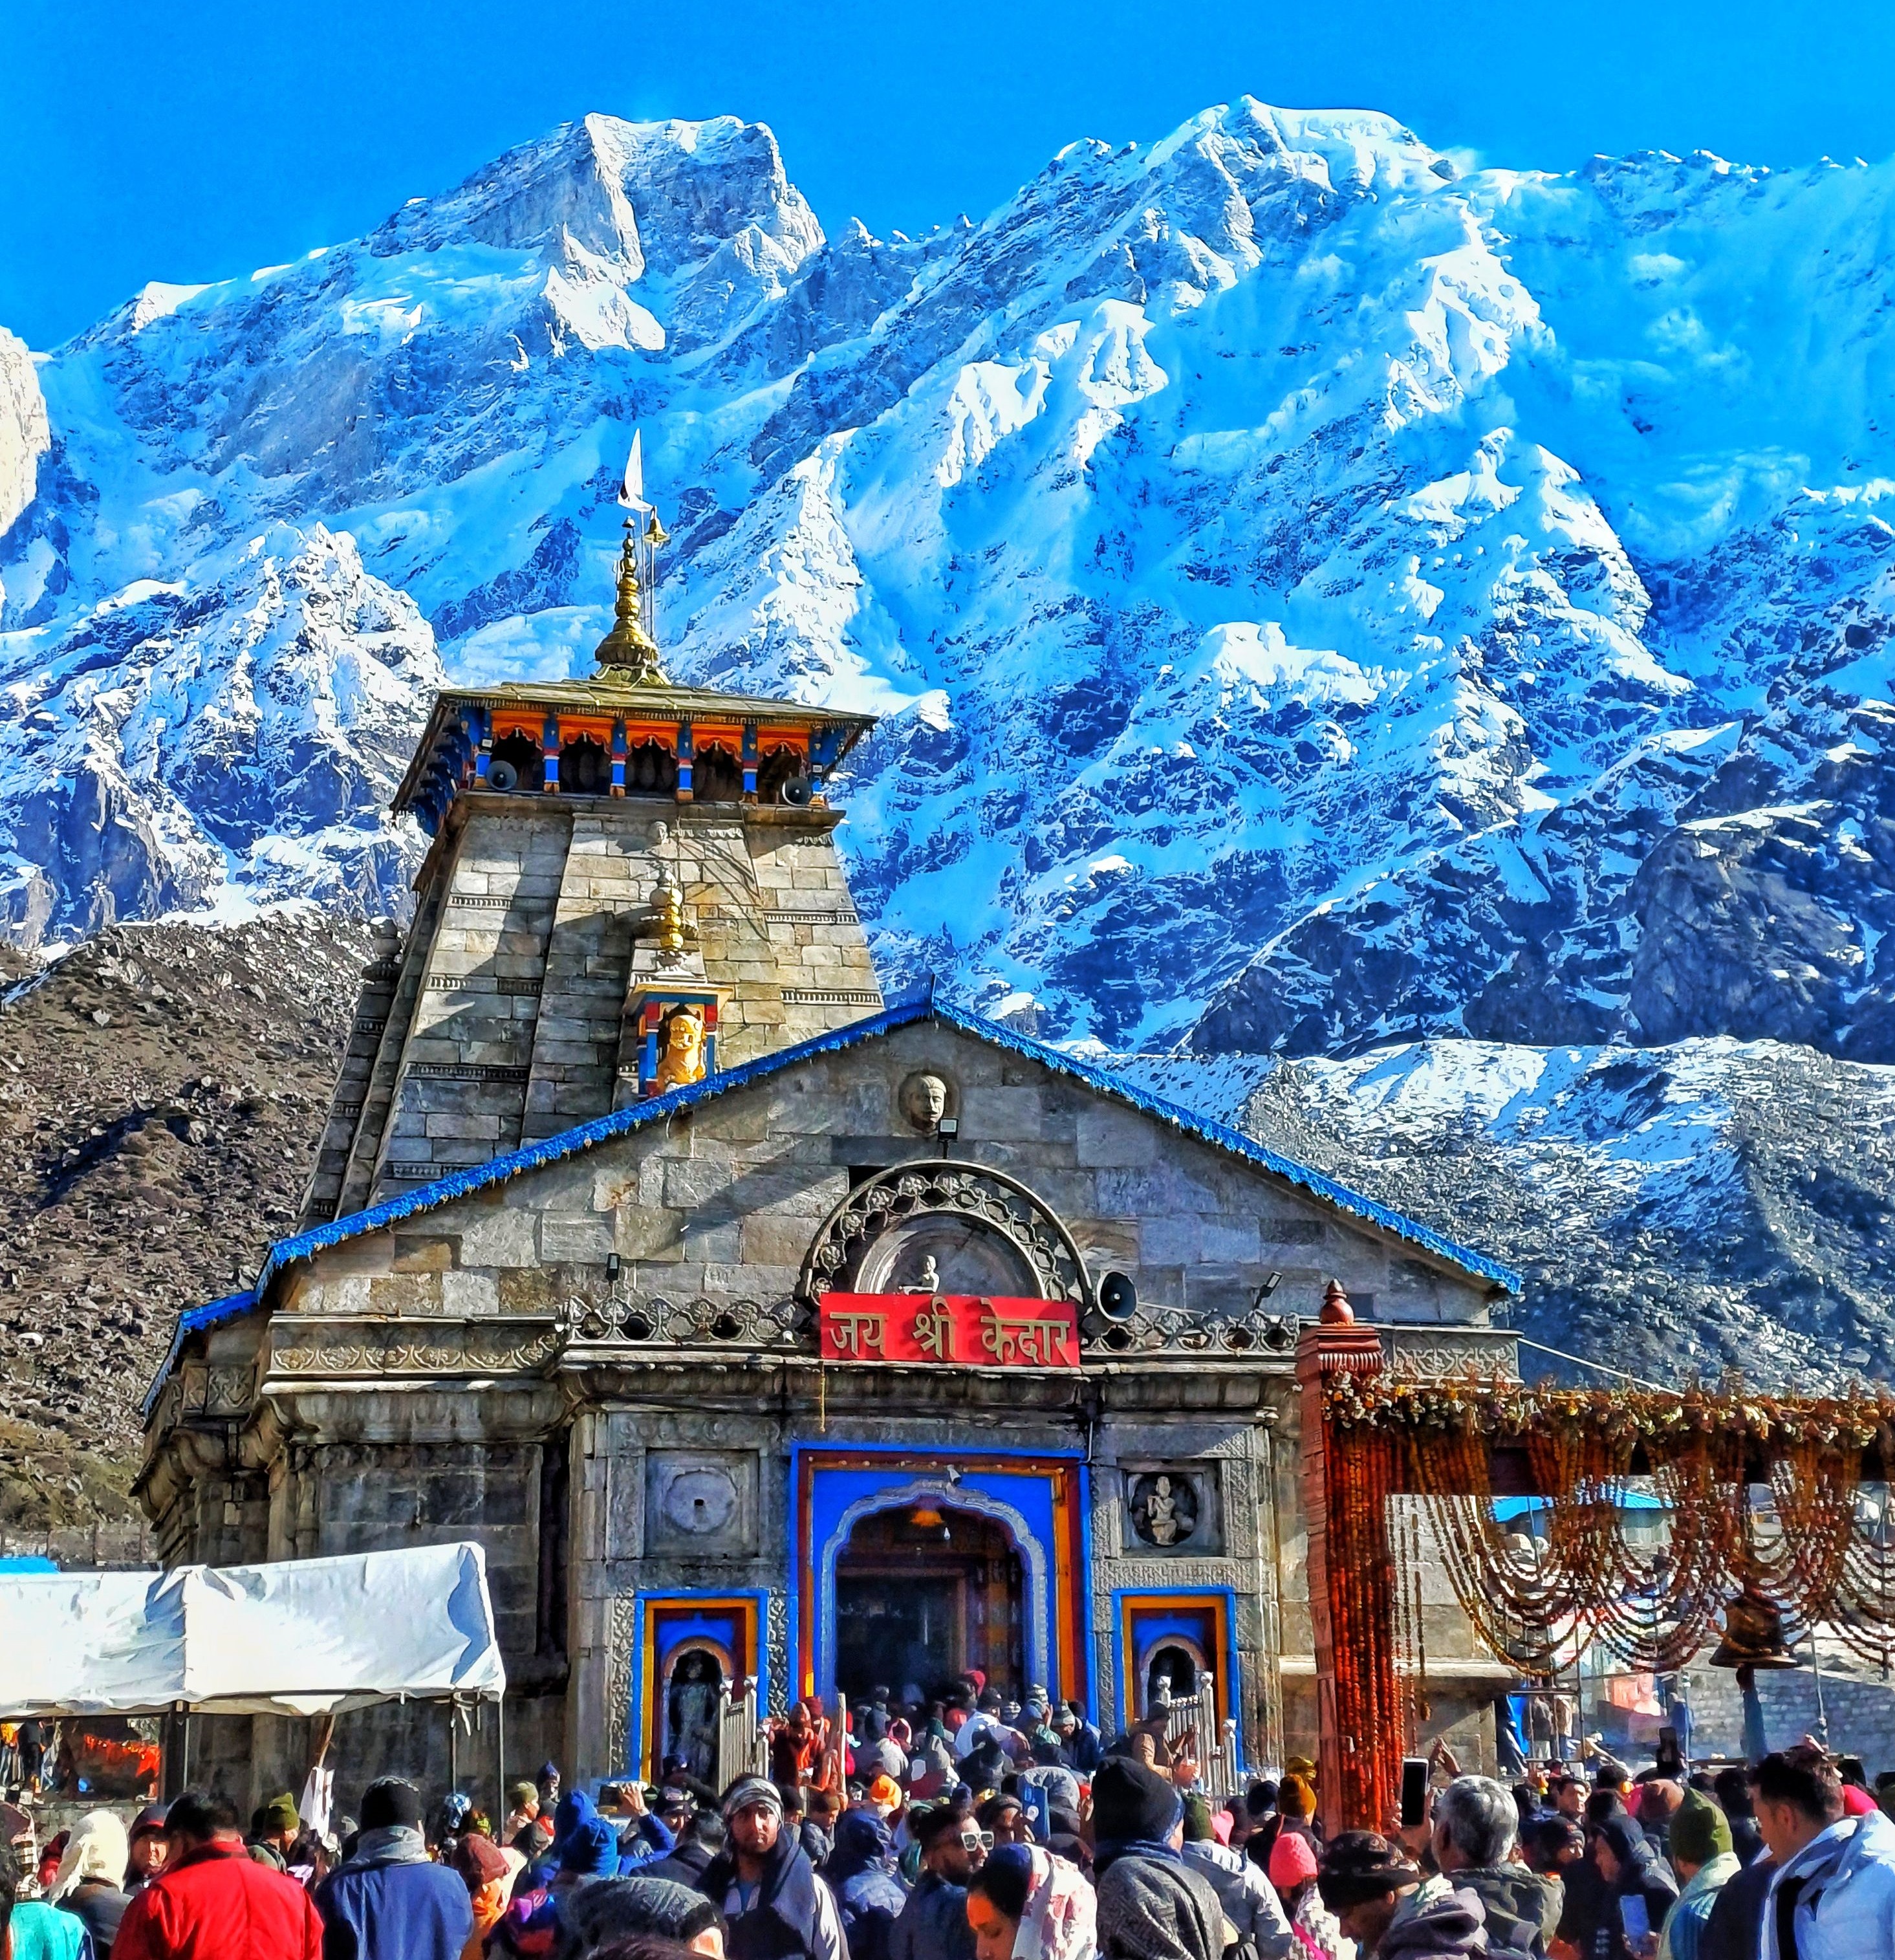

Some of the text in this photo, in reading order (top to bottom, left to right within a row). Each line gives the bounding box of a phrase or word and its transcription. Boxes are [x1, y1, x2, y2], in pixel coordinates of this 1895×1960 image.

[830, 1297, 1071, 1364] जय श्री केदार
